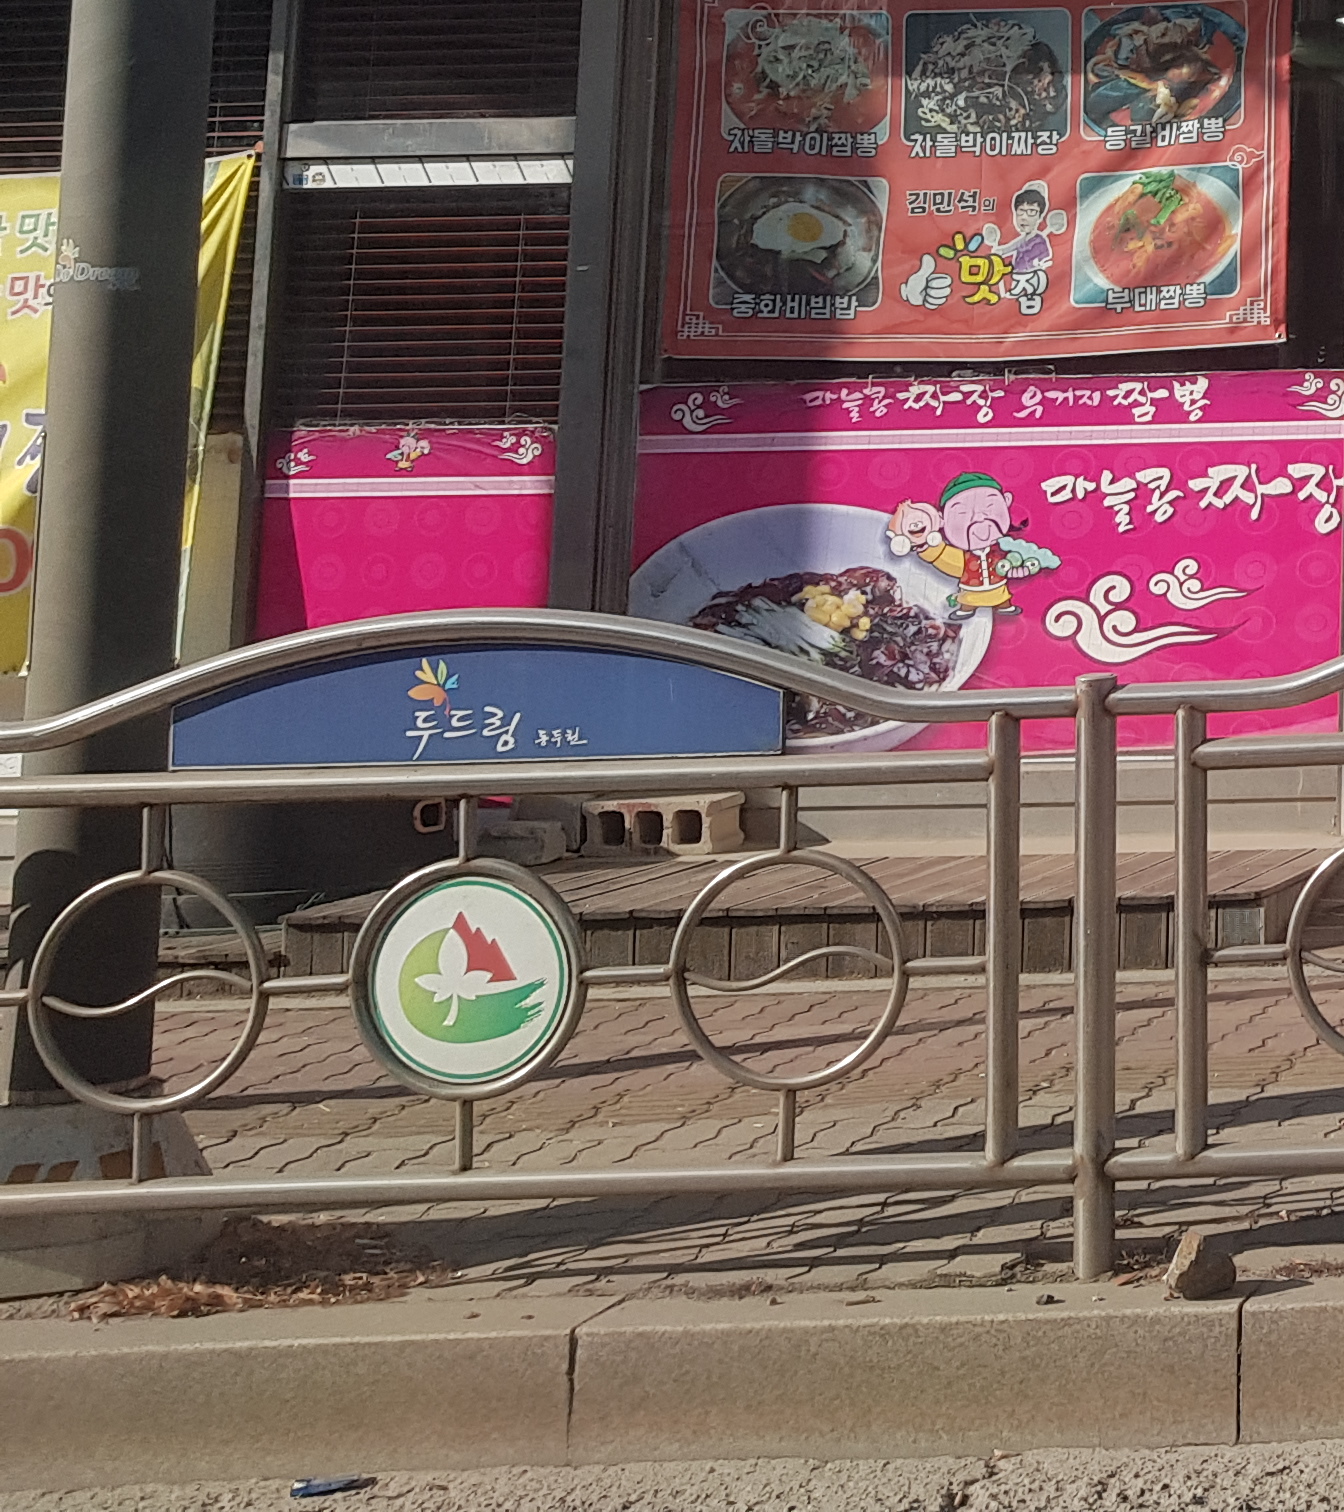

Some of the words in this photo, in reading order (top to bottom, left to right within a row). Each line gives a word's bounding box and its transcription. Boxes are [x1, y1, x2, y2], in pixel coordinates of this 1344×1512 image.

[728, 128, 878, 157] 차돌박이짬뽕
[910, 131, 1059, 158] 차돌박이짜장
[1105, 117, 1225, 150] 등갈비짬뽕
[959, 255, 1049, 316] 맛집
[1106, 283, 1208, 313] 부대짬뽕
[731, 293, 858, 319] 중화비빔밥
[405, 705, 522, 761] 두드림
